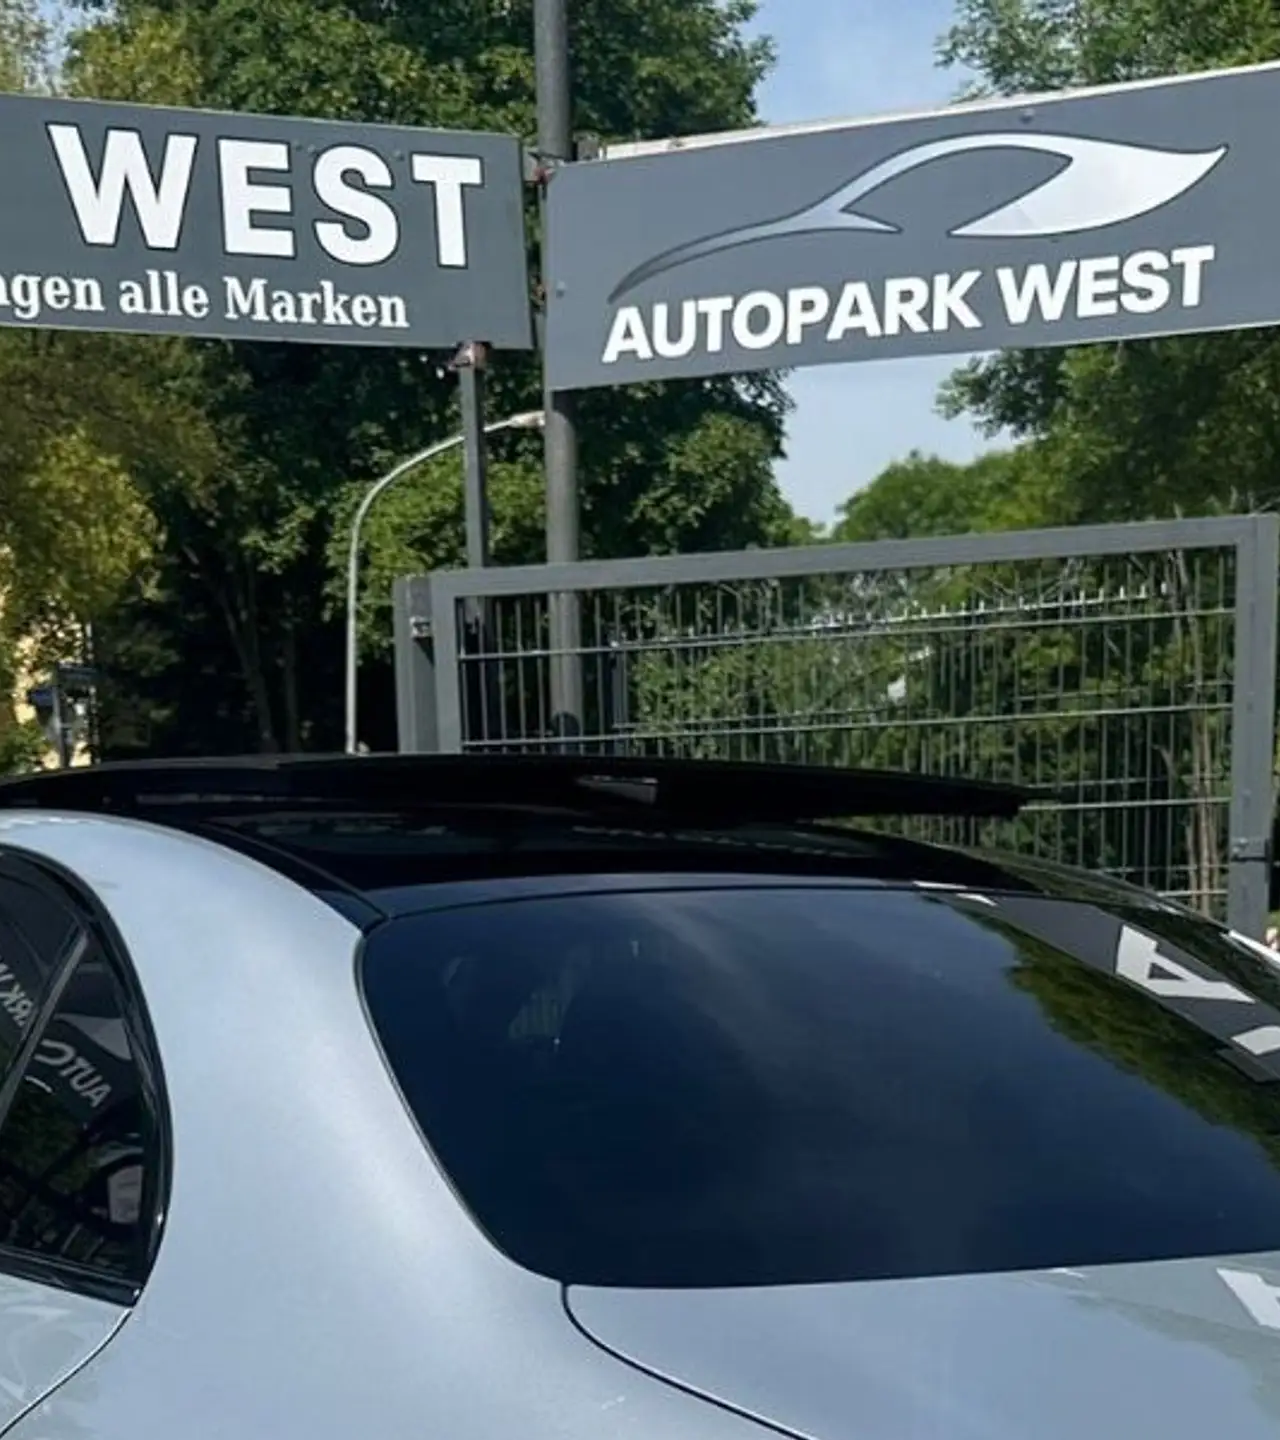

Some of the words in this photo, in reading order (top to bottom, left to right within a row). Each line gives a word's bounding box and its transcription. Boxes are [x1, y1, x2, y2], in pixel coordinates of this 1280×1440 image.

[48, 124, 482, 267] WEST
[119, 269, 209, 318] alle
[223, 276, 409, 328] Marken
[601, 270, 982, 364] AUTOPARK
[996, 245, 1215, 325] WEST
